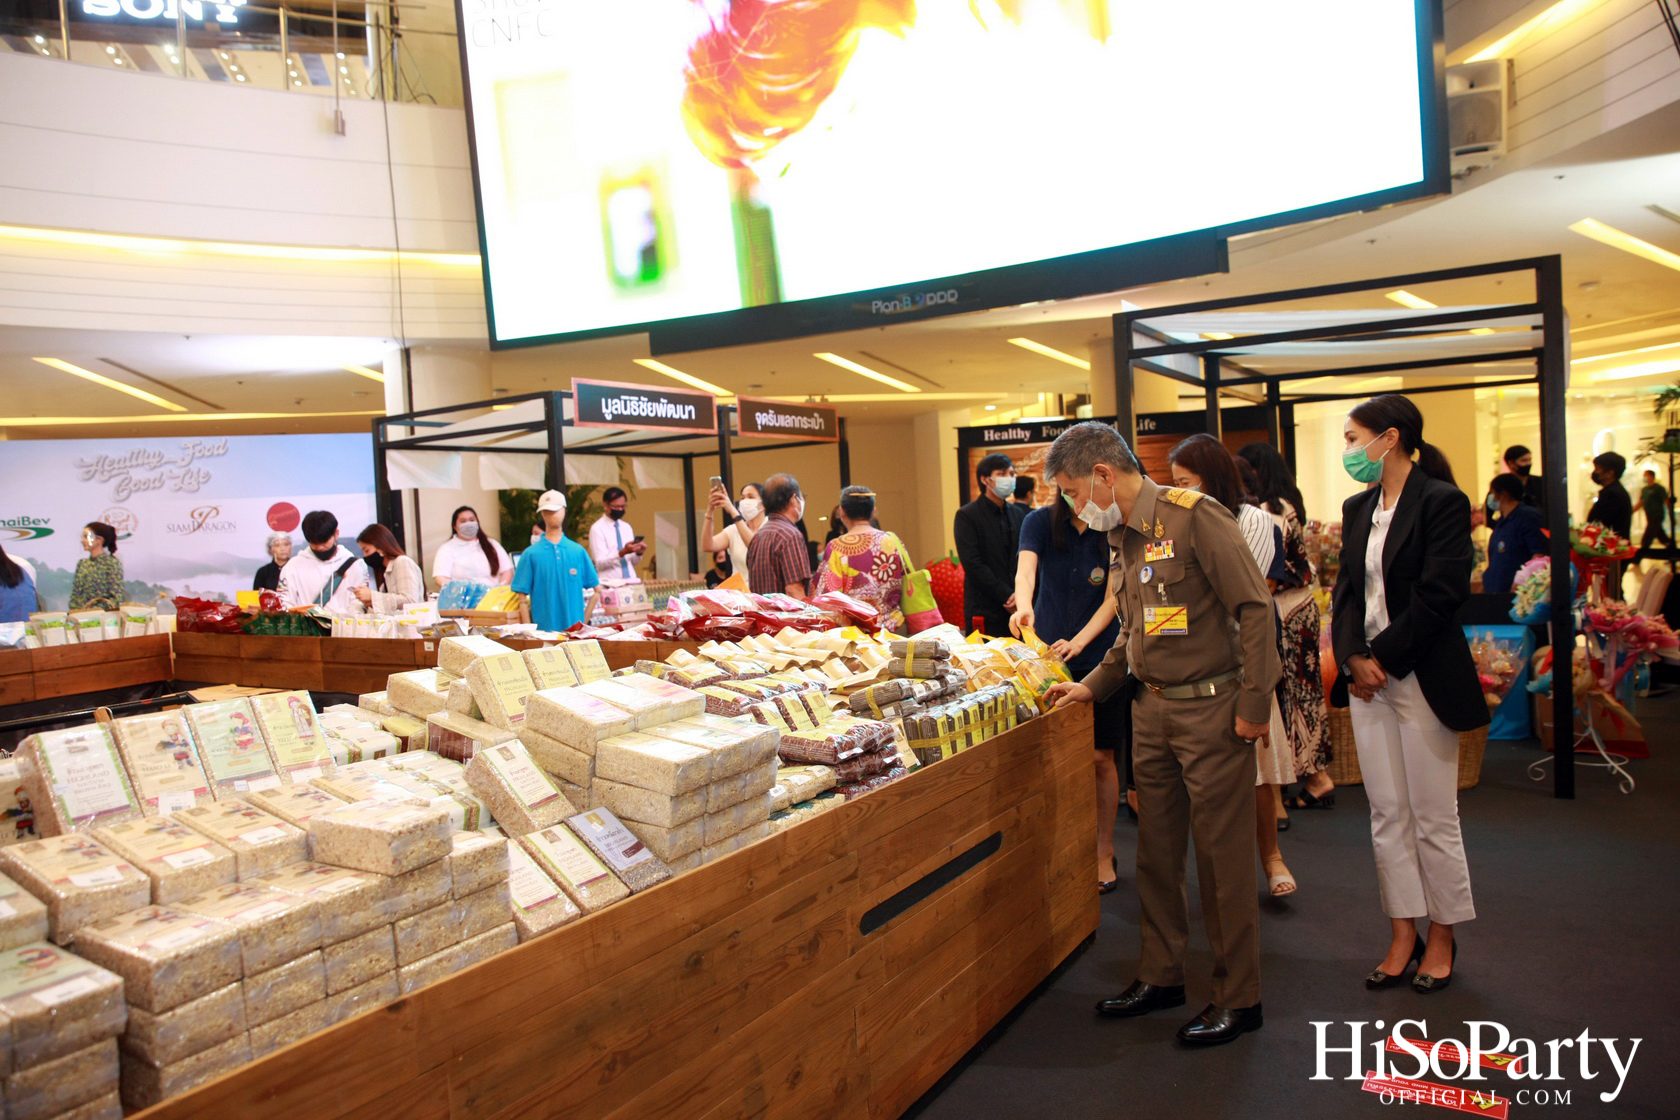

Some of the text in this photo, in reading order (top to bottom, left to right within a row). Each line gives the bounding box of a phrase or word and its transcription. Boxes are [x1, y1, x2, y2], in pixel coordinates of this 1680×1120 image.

[601, 395, 696, 420] มูลนิธิชัยพัฒนา
[983, 418, 1157, 442] Healthy Foo ife
[74, 438, 229, 482] Healthy Food
[111, 467, 212, 502] Good Life
[167, 523, 191, 533] SIAM
